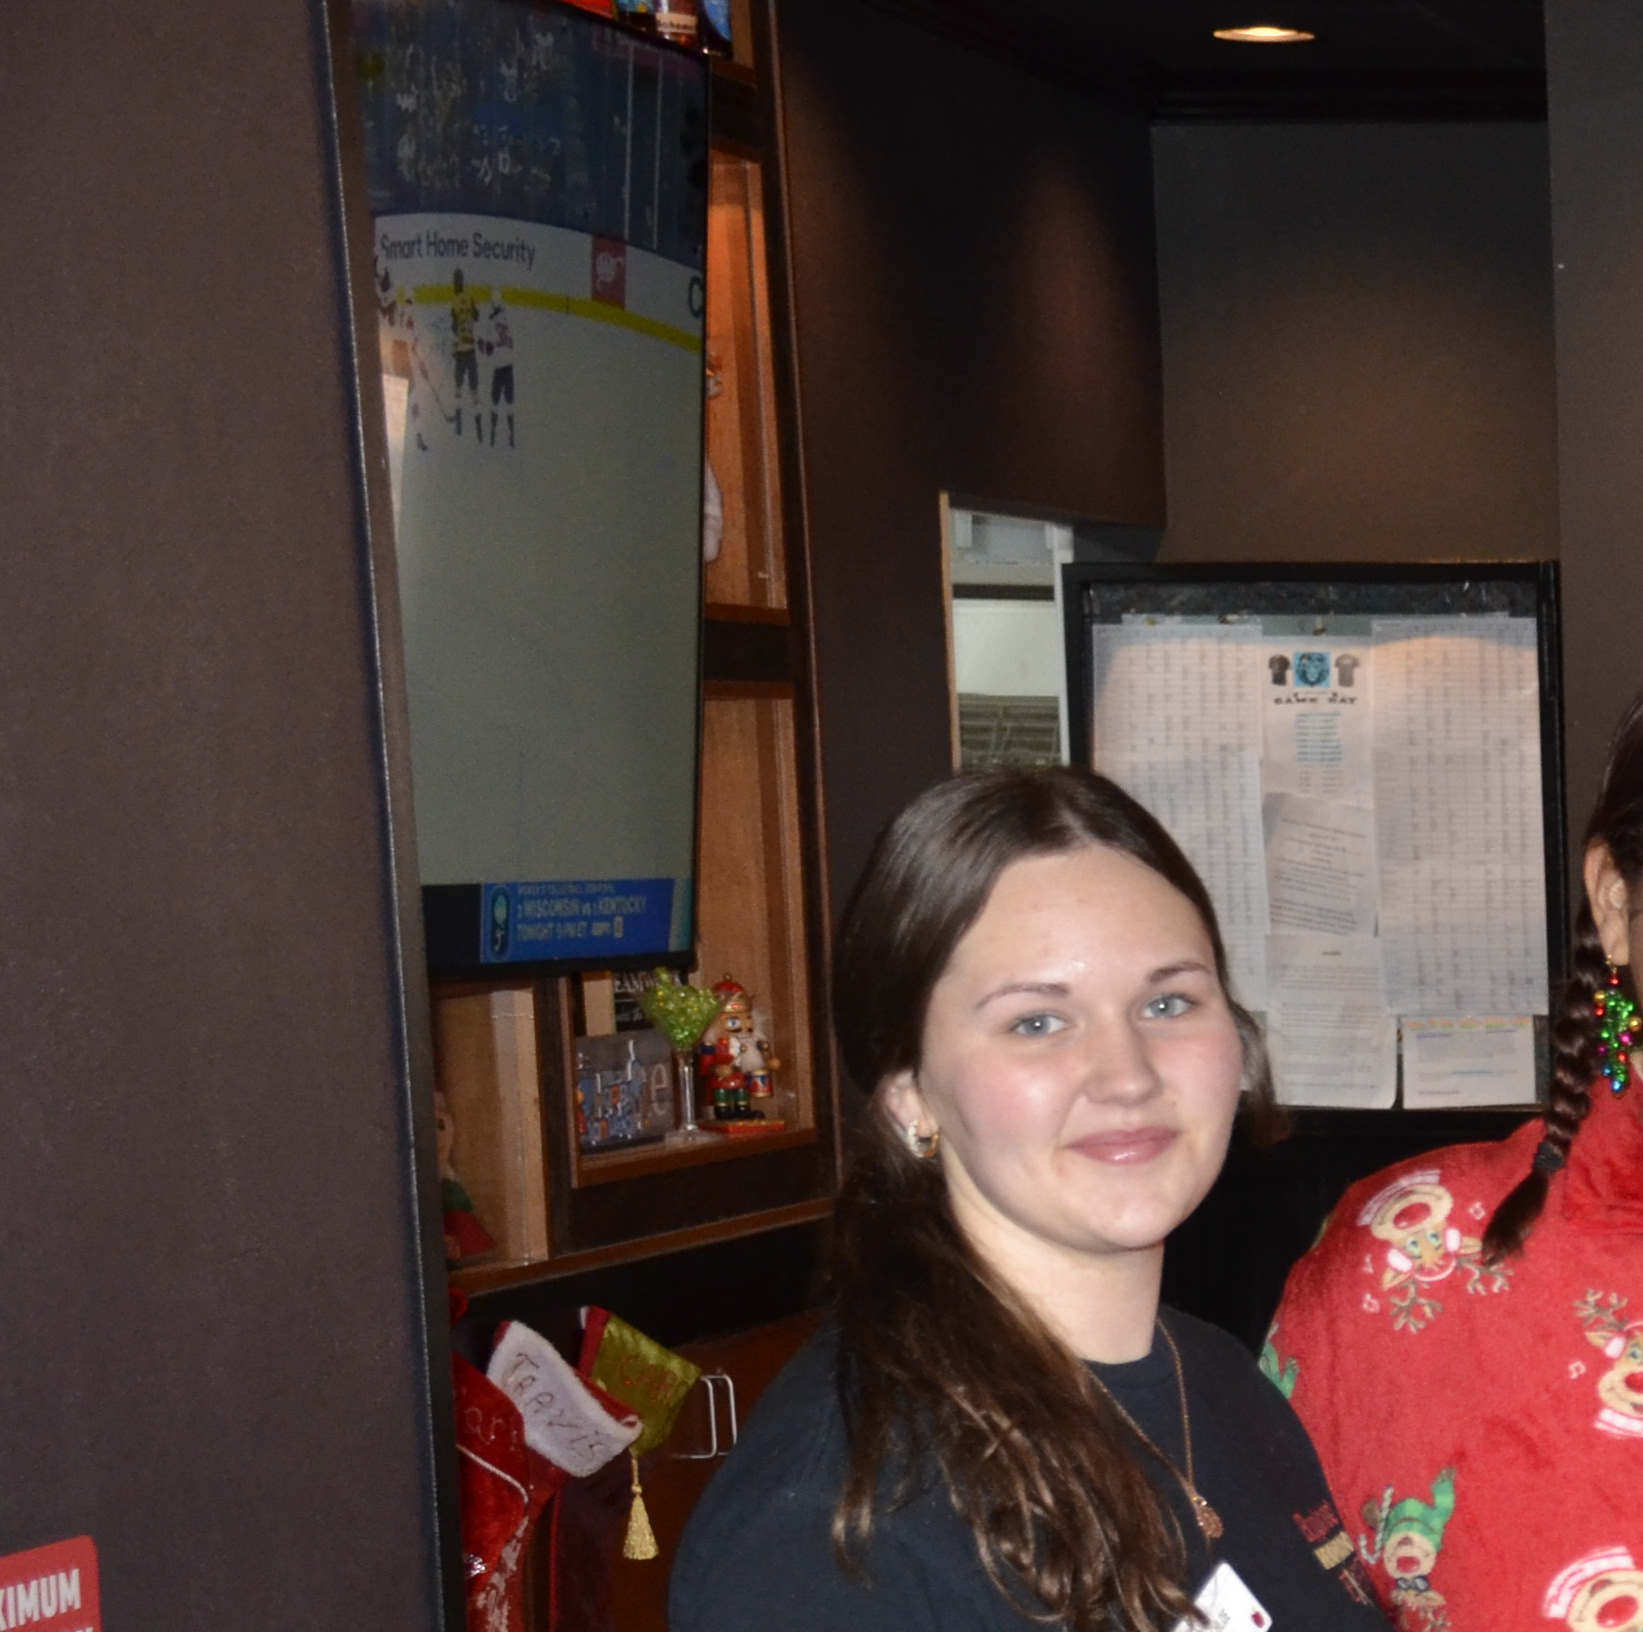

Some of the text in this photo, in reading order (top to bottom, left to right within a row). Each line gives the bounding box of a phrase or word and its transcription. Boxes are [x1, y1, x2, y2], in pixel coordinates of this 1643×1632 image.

[380, 230, 536, 271] Smart Home Security
[0, 1568, 82, 1632] IMUM
